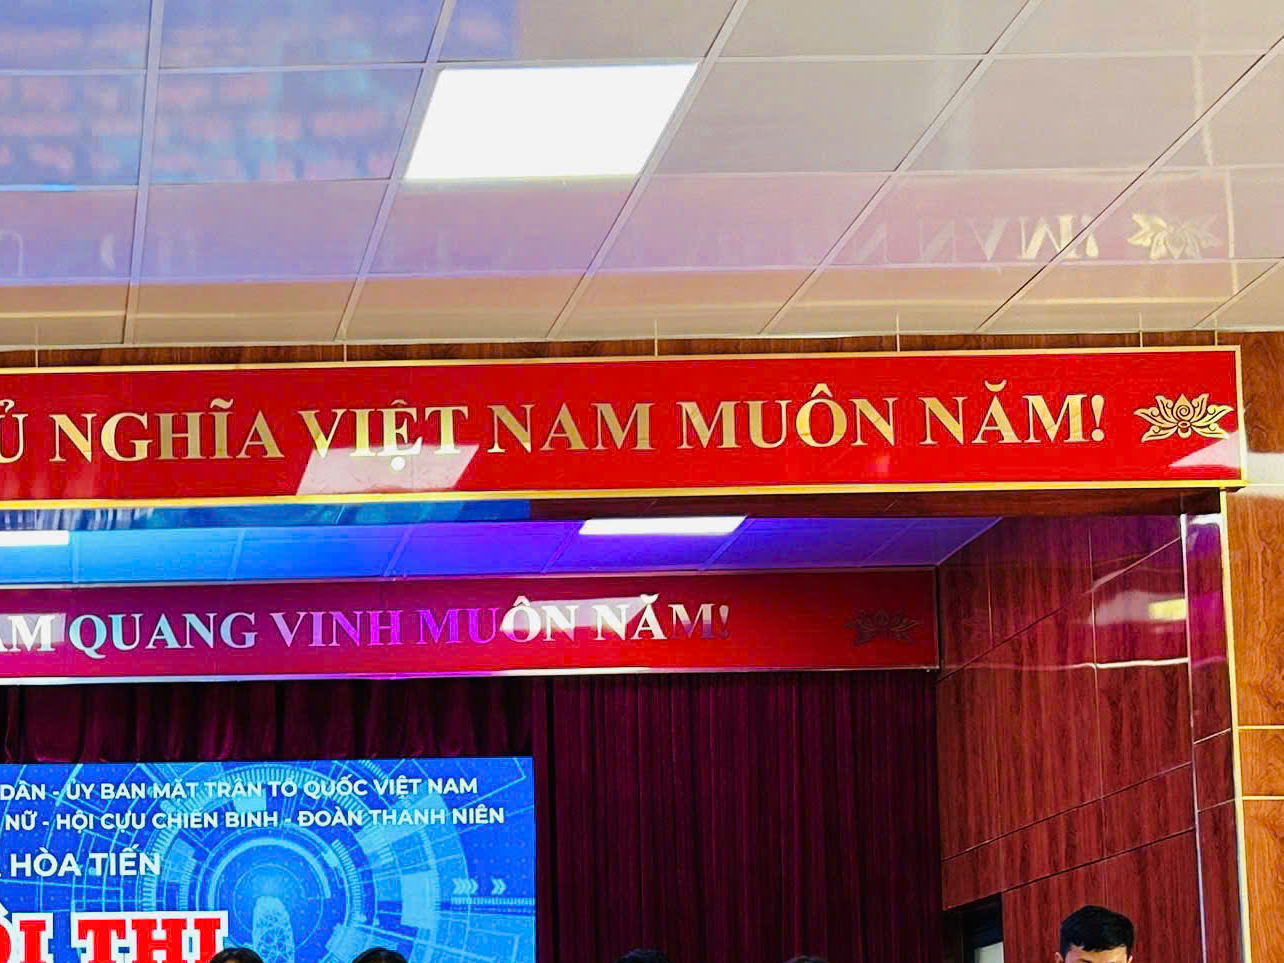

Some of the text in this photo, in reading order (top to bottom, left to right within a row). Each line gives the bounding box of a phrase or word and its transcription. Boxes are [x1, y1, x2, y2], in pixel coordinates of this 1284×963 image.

[52, 397, 283, 464] NGHĨA
[295, 398, 471, 470] VIỆT
[487, 402, 653, 452] NAM
[676, 383, 898, 450] MUÔN
[919, 379, 1106, 446] NĂM!
[68, 612, 257, 658] QUANG
[273, 610, 403, 647] VINH
[415, 596, 579, 645] MUÔN
[592, 594, 730, 642] NĂM!
[0, 780, 46, 801] DÂN
[66, 778, 95, 800] ỦY
[99, 783, 146, 800] BAN
[153, 778, 199, 804] MẶT
[303, 774, 368, 800] QUỐC
[373, 775, 422, 799] VIỆT
[428, 777, 478, 795] NAM
[6, 810, 38, 831] NỮ
[56, 809, 93, 833] HỘI
[100, 810, 146, 832] CỰU
[225, 811, 277, 828] BINH
[297, 806, 362, 827] ĐOÀN
[367, 810, 446, 826] THANH
[452, 803, 505, 824] NIÊN
[10, 848, 81, 877] HÒA
[85, 844, 161, 876] TIẾN
